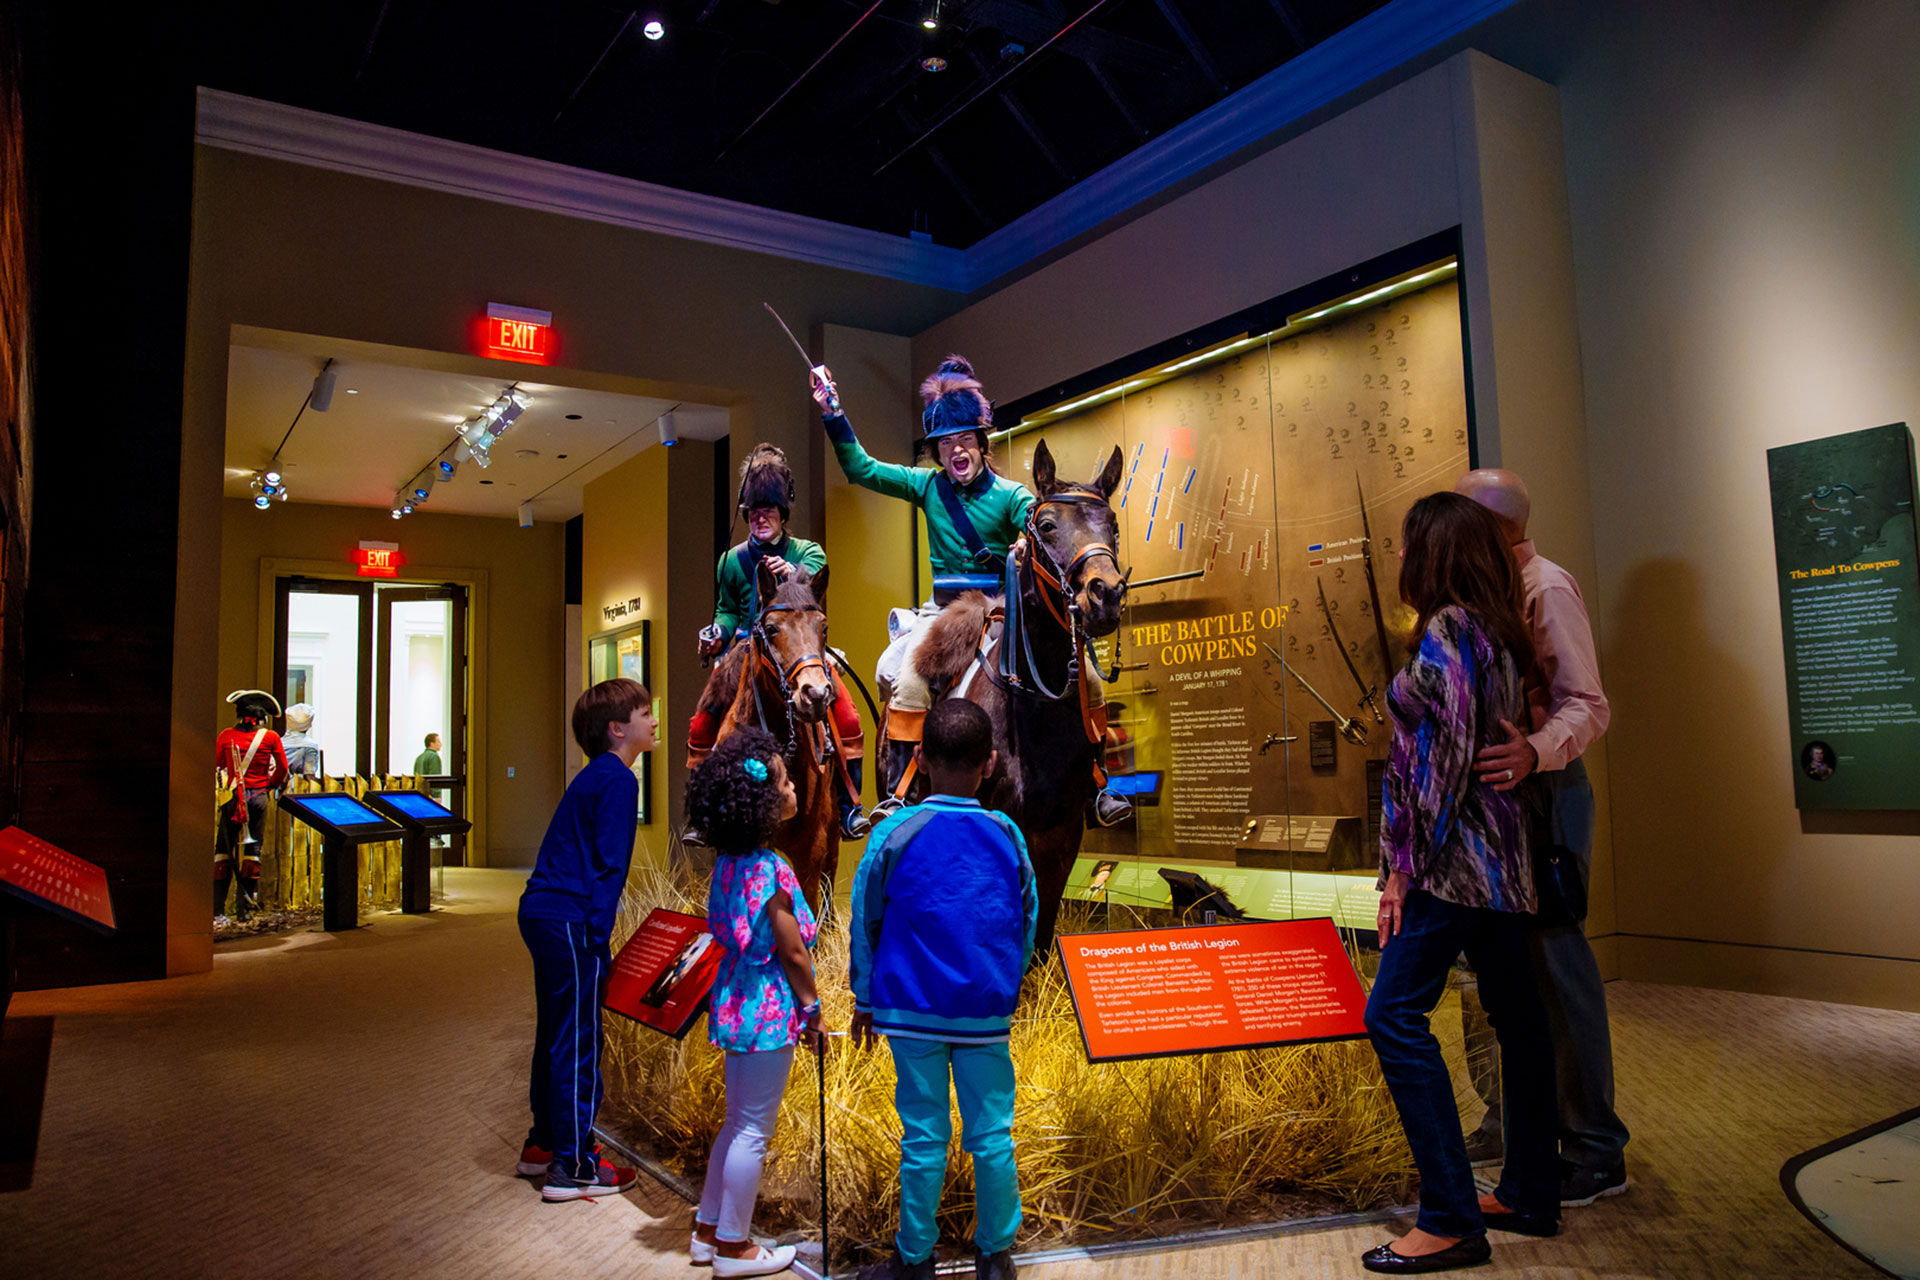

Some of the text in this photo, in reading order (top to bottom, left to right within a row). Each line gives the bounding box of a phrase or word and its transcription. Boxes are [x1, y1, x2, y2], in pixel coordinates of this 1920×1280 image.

[501, 321, 537, 350] EXIT
[368, 551, 390, 567] EXIT
[1789, 559, 1900, 579] The Road To Cowpens
[1132, 606, 1289, 647] THE BATTLE OF
[1161, 635, 1257, 666] COWPENS
[1175, 673, 1192, 681] DEVIL
[1193, 671, 1202, 680] OF
[1209, 667, 1242, 678] WHIPPING
[1182, 682, 1206, 690] JANUARY
[1080, 938, 1240, 958] Dragoons of the British Legion
